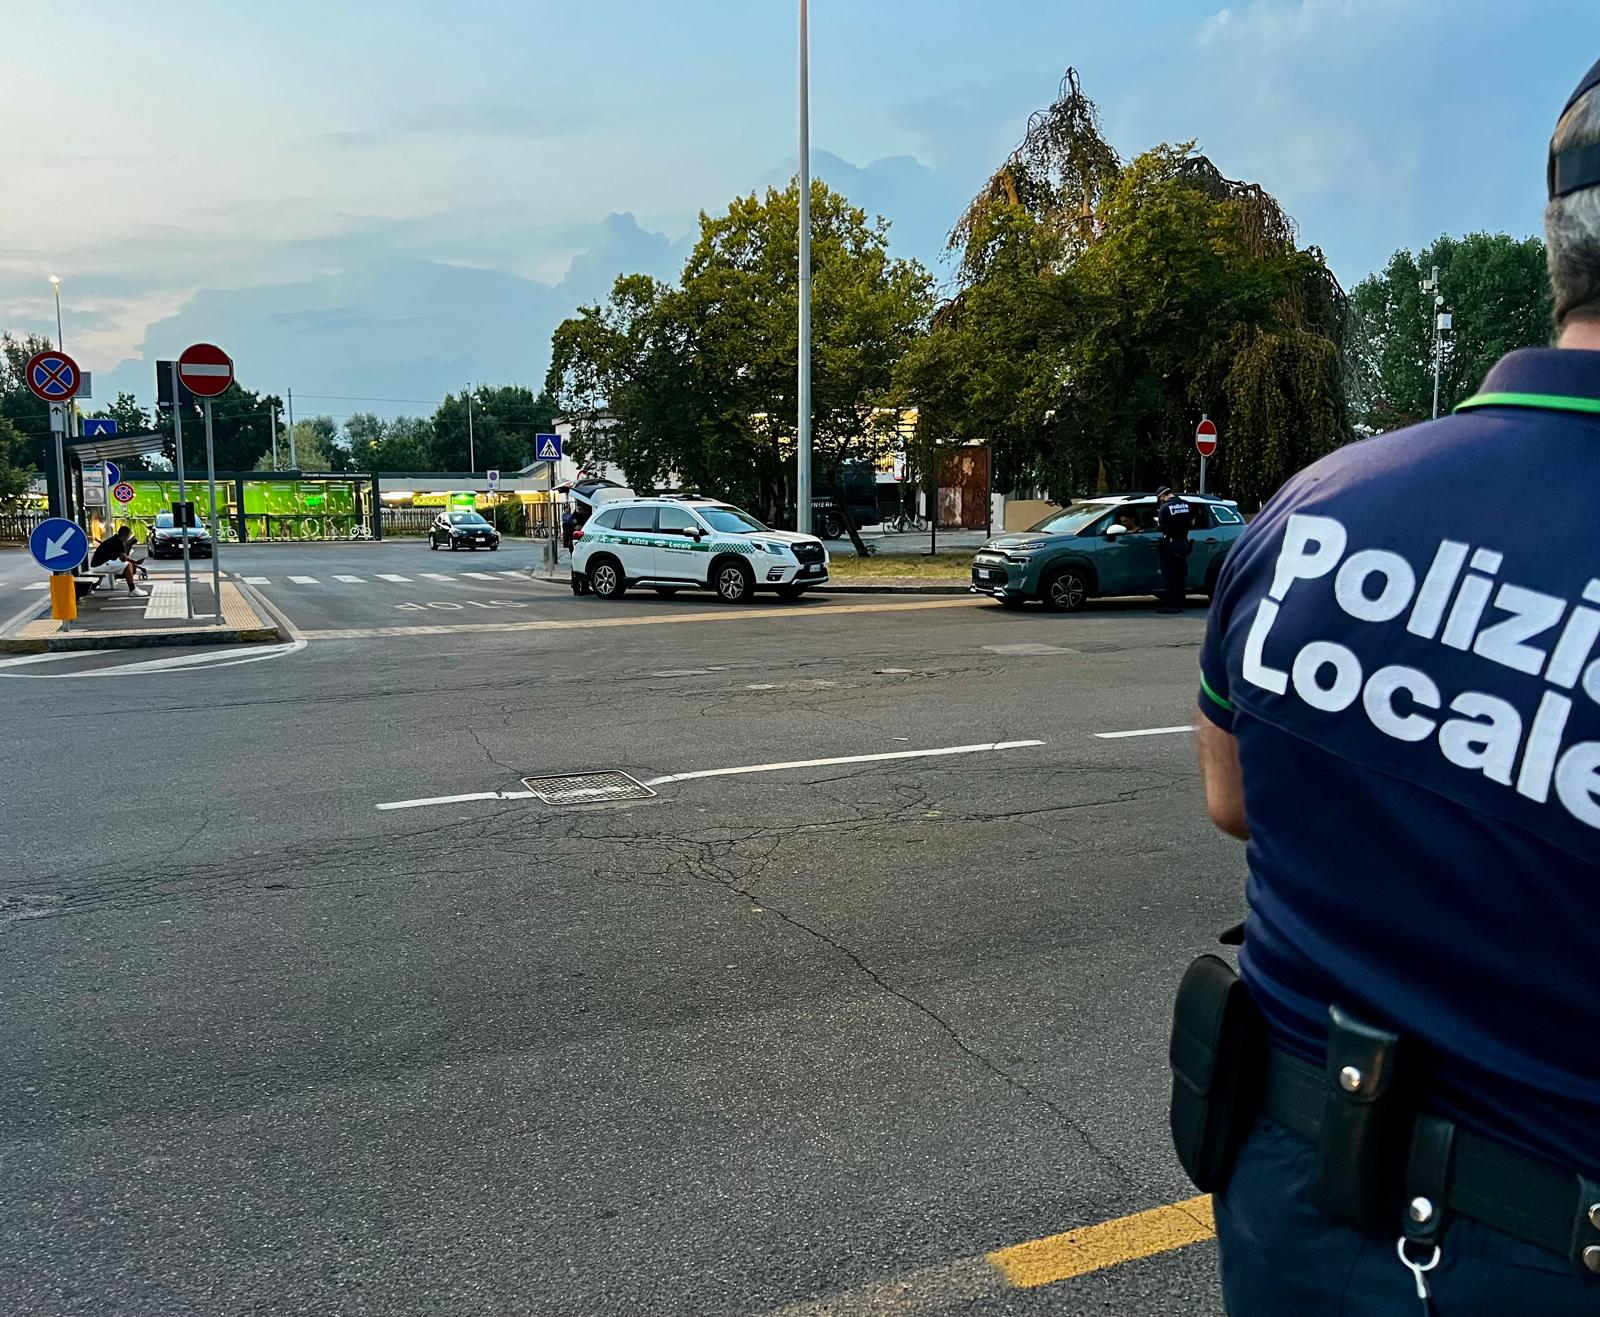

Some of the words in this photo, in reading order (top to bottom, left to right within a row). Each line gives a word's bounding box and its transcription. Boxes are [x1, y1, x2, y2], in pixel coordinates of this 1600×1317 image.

[413, 494, 447, 505] GORGONZ
[627, 537, 649, 546] Polizia
[668, 542, 692, 550] Locale
[1269, 514, 1600, 706] Polizi
[1242, 598, 1600, 830] Locale
